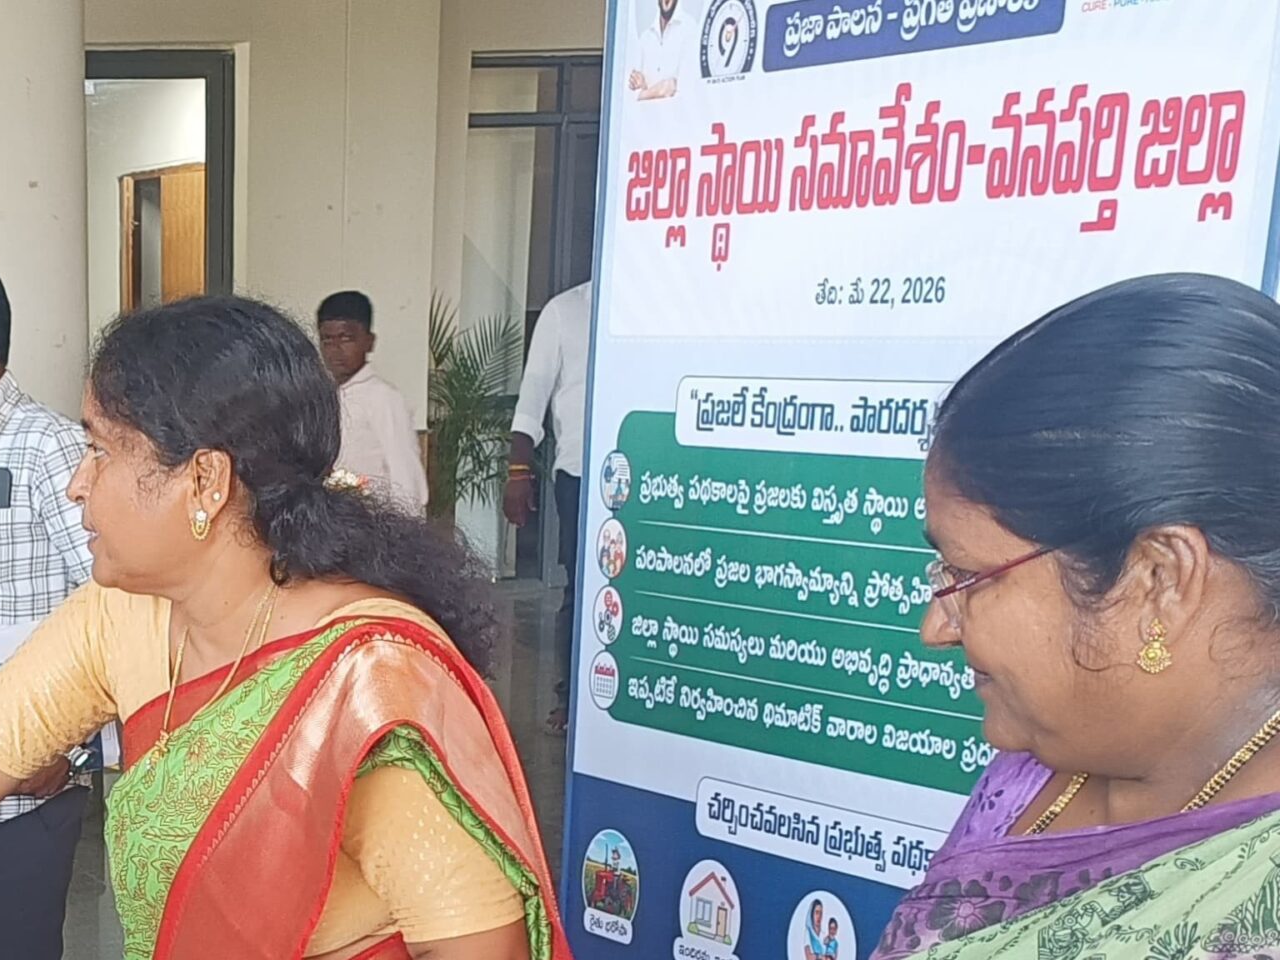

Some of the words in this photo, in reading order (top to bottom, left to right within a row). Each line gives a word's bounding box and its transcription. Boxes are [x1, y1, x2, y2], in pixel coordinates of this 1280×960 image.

[783, 12, 825, 58] ప్రజా
[825, 2, 883, 39] పాలన
[626, 146, 691, 248] జిల్లా
[696, 123, 785, 271] స్థాయి
[789, 82, 1129, 233] సమావేశం-వనపర్తి
[1134, 89, 1246, 222] జిల్లా
[814, 280, 844, 306] తేది:
[847, 278, 864, 306] మే
[868, 277, 897, 309] 22,
[901, 276, 946, 305] 2026
[639, 470, 683, 508] ప్రభుత్వ
[688, 475, 750, 514] పథకాలపై
[753, 480, 807, 514] ప్రజలకు
[811, 484, 858, 524] విస్తృత
[863, 488, 908, 535] స్థాయి
[635, 545, 712, 578] పరిపాలనలో
[714, 558, 751, 588] ప్రజల
[754, 565, 859, 608] భాగస్వామ్యాన్ని
[631, 614, 658, 650] జిల్లా
[662, 620, 699, 658] స్థాయి
[703, 625, 766, 658] సమస్యలు
[769, 636, 828, 667] మరియు
[831, 643, 894, 694] అభివృద్ధి
[627, 674, 678, 709] ఇప్పటికే
[680, 685, 759, 721] నిర్వహించిన
[826, 716, 878, 744] వారాల
[881, 724, 958, 760] విజయాల
[707, 791, 821, 847] చర్చించవలసిన
[824, 820, 887, 872] ప్రభుత్వ
